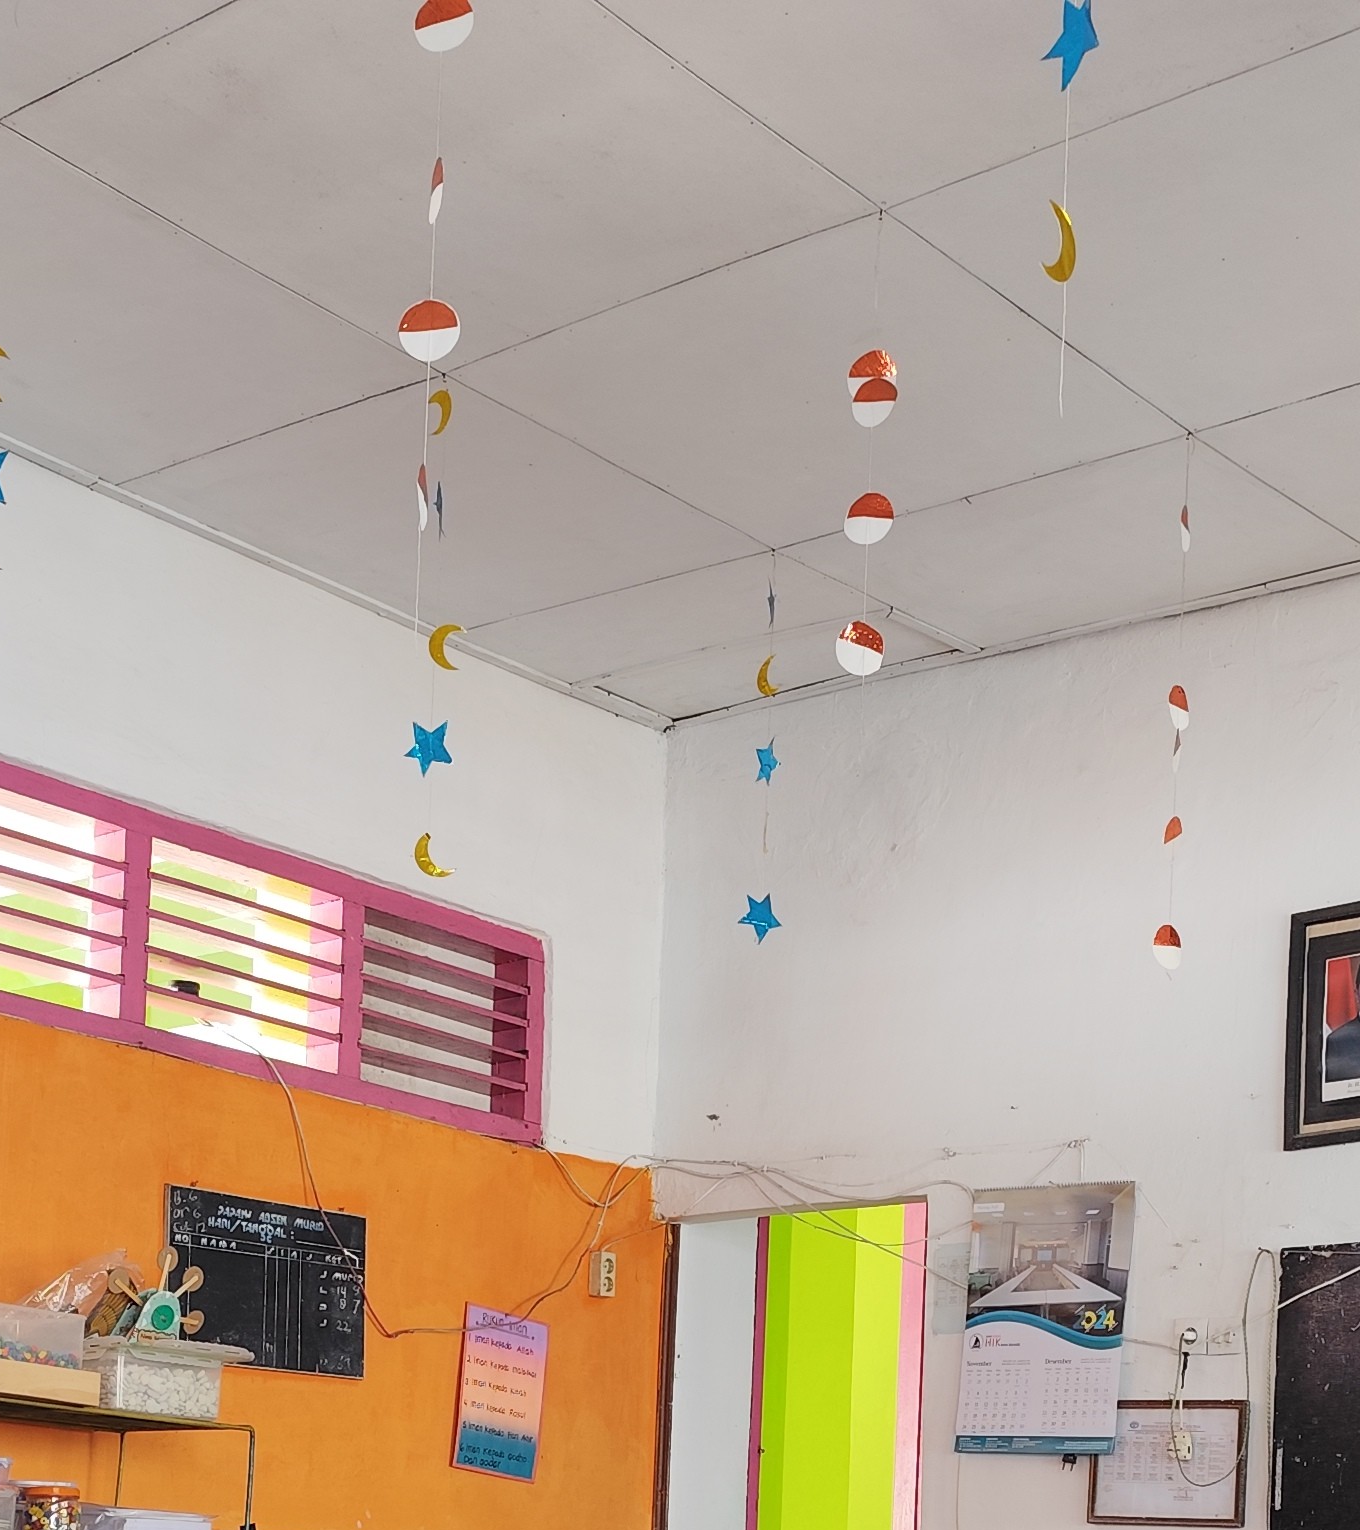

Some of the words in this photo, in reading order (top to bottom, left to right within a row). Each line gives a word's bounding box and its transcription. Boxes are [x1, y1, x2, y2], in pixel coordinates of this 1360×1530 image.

[293, 1217, 325, 1232] MURID
[1072, 1303, 1119, 1334] 2024
[966, 1360, 993, 1368] November
[1044, 1357, 1072, 1365] Desember
